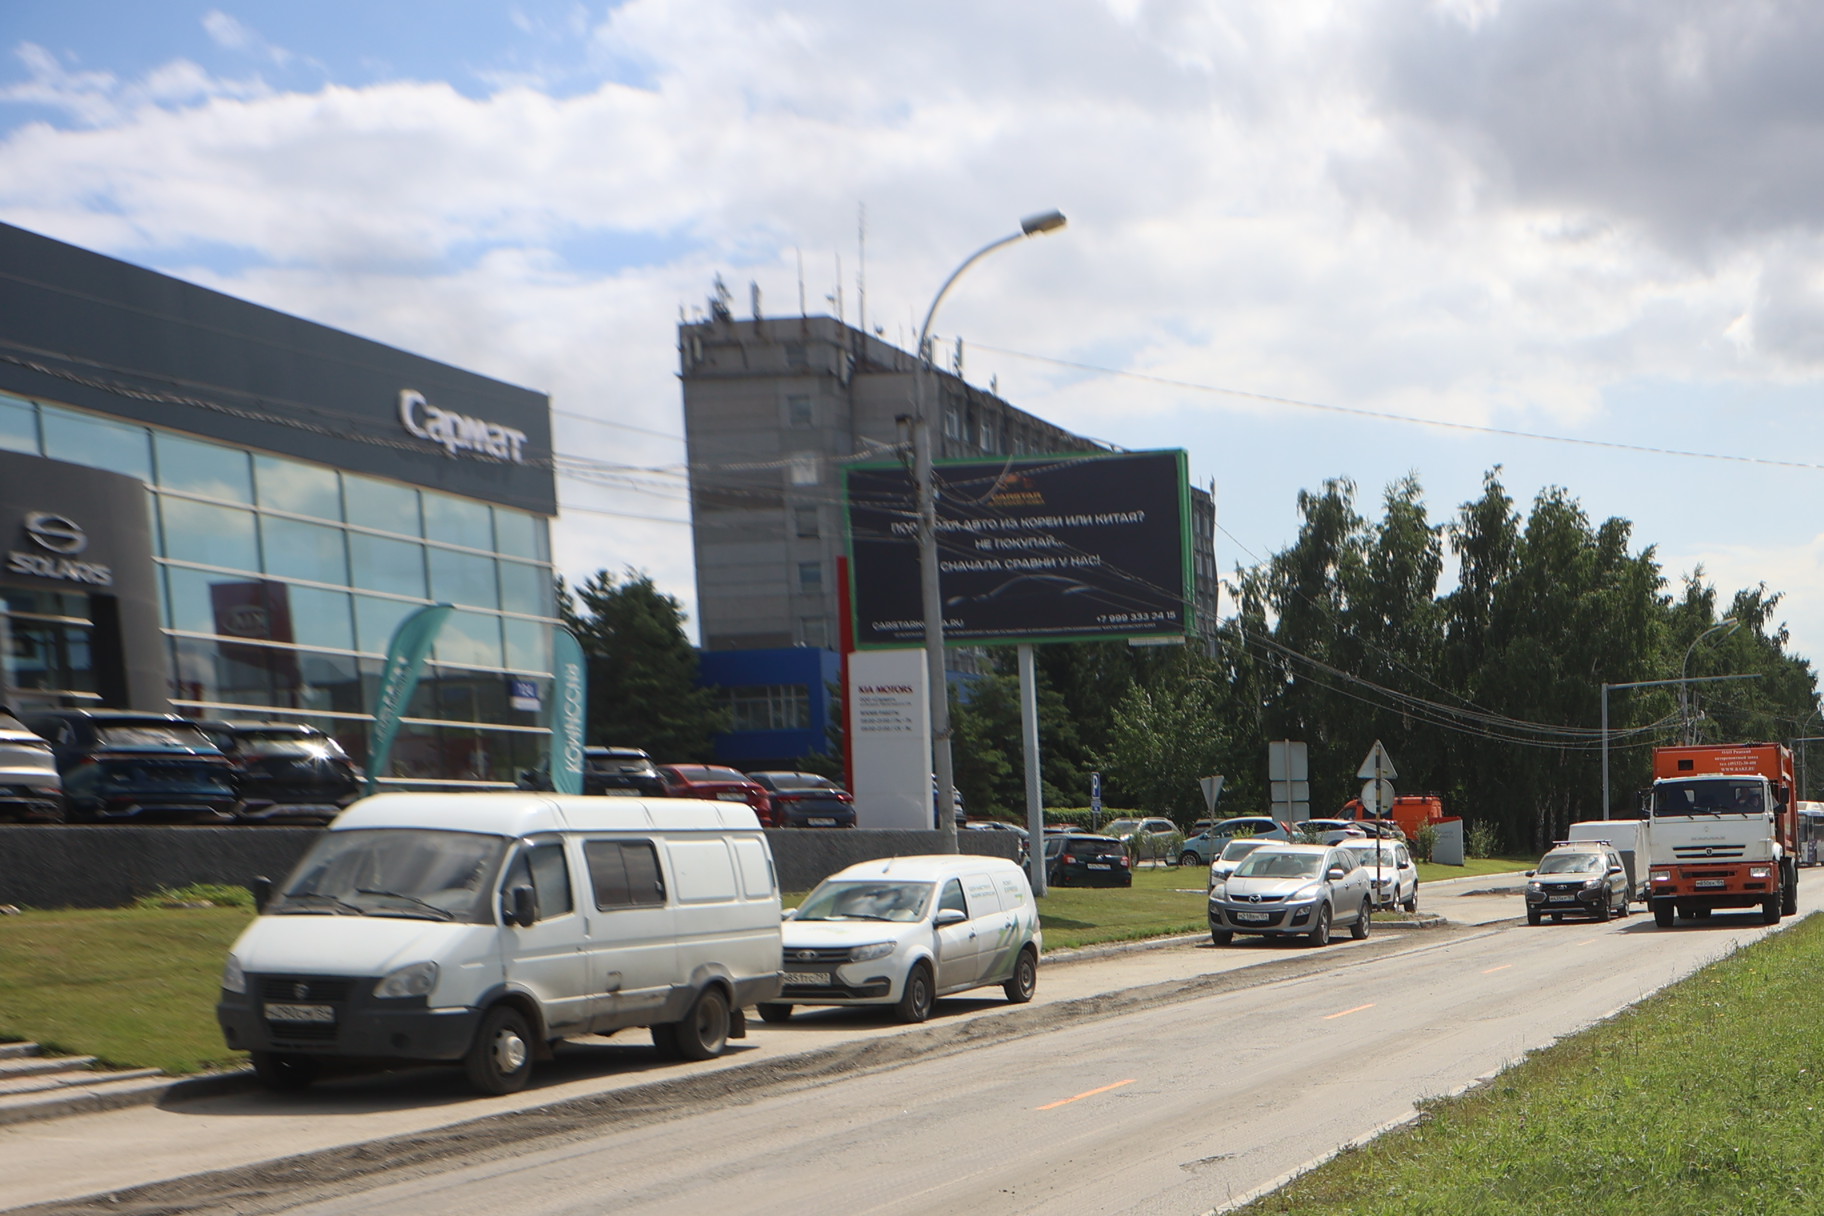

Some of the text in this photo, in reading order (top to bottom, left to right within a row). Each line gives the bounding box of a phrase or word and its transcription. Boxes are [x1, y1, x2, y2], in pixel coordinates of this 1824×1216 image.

[398, 389, 528, 464] Сармат
[974, 540, 992, 550] НЕ
[5, 550, 113, 586] SOLARIS
[940, 560, 1003, 573] СНАЧАЛА
[1004, 557, 1057, 571] СРАВНИ
